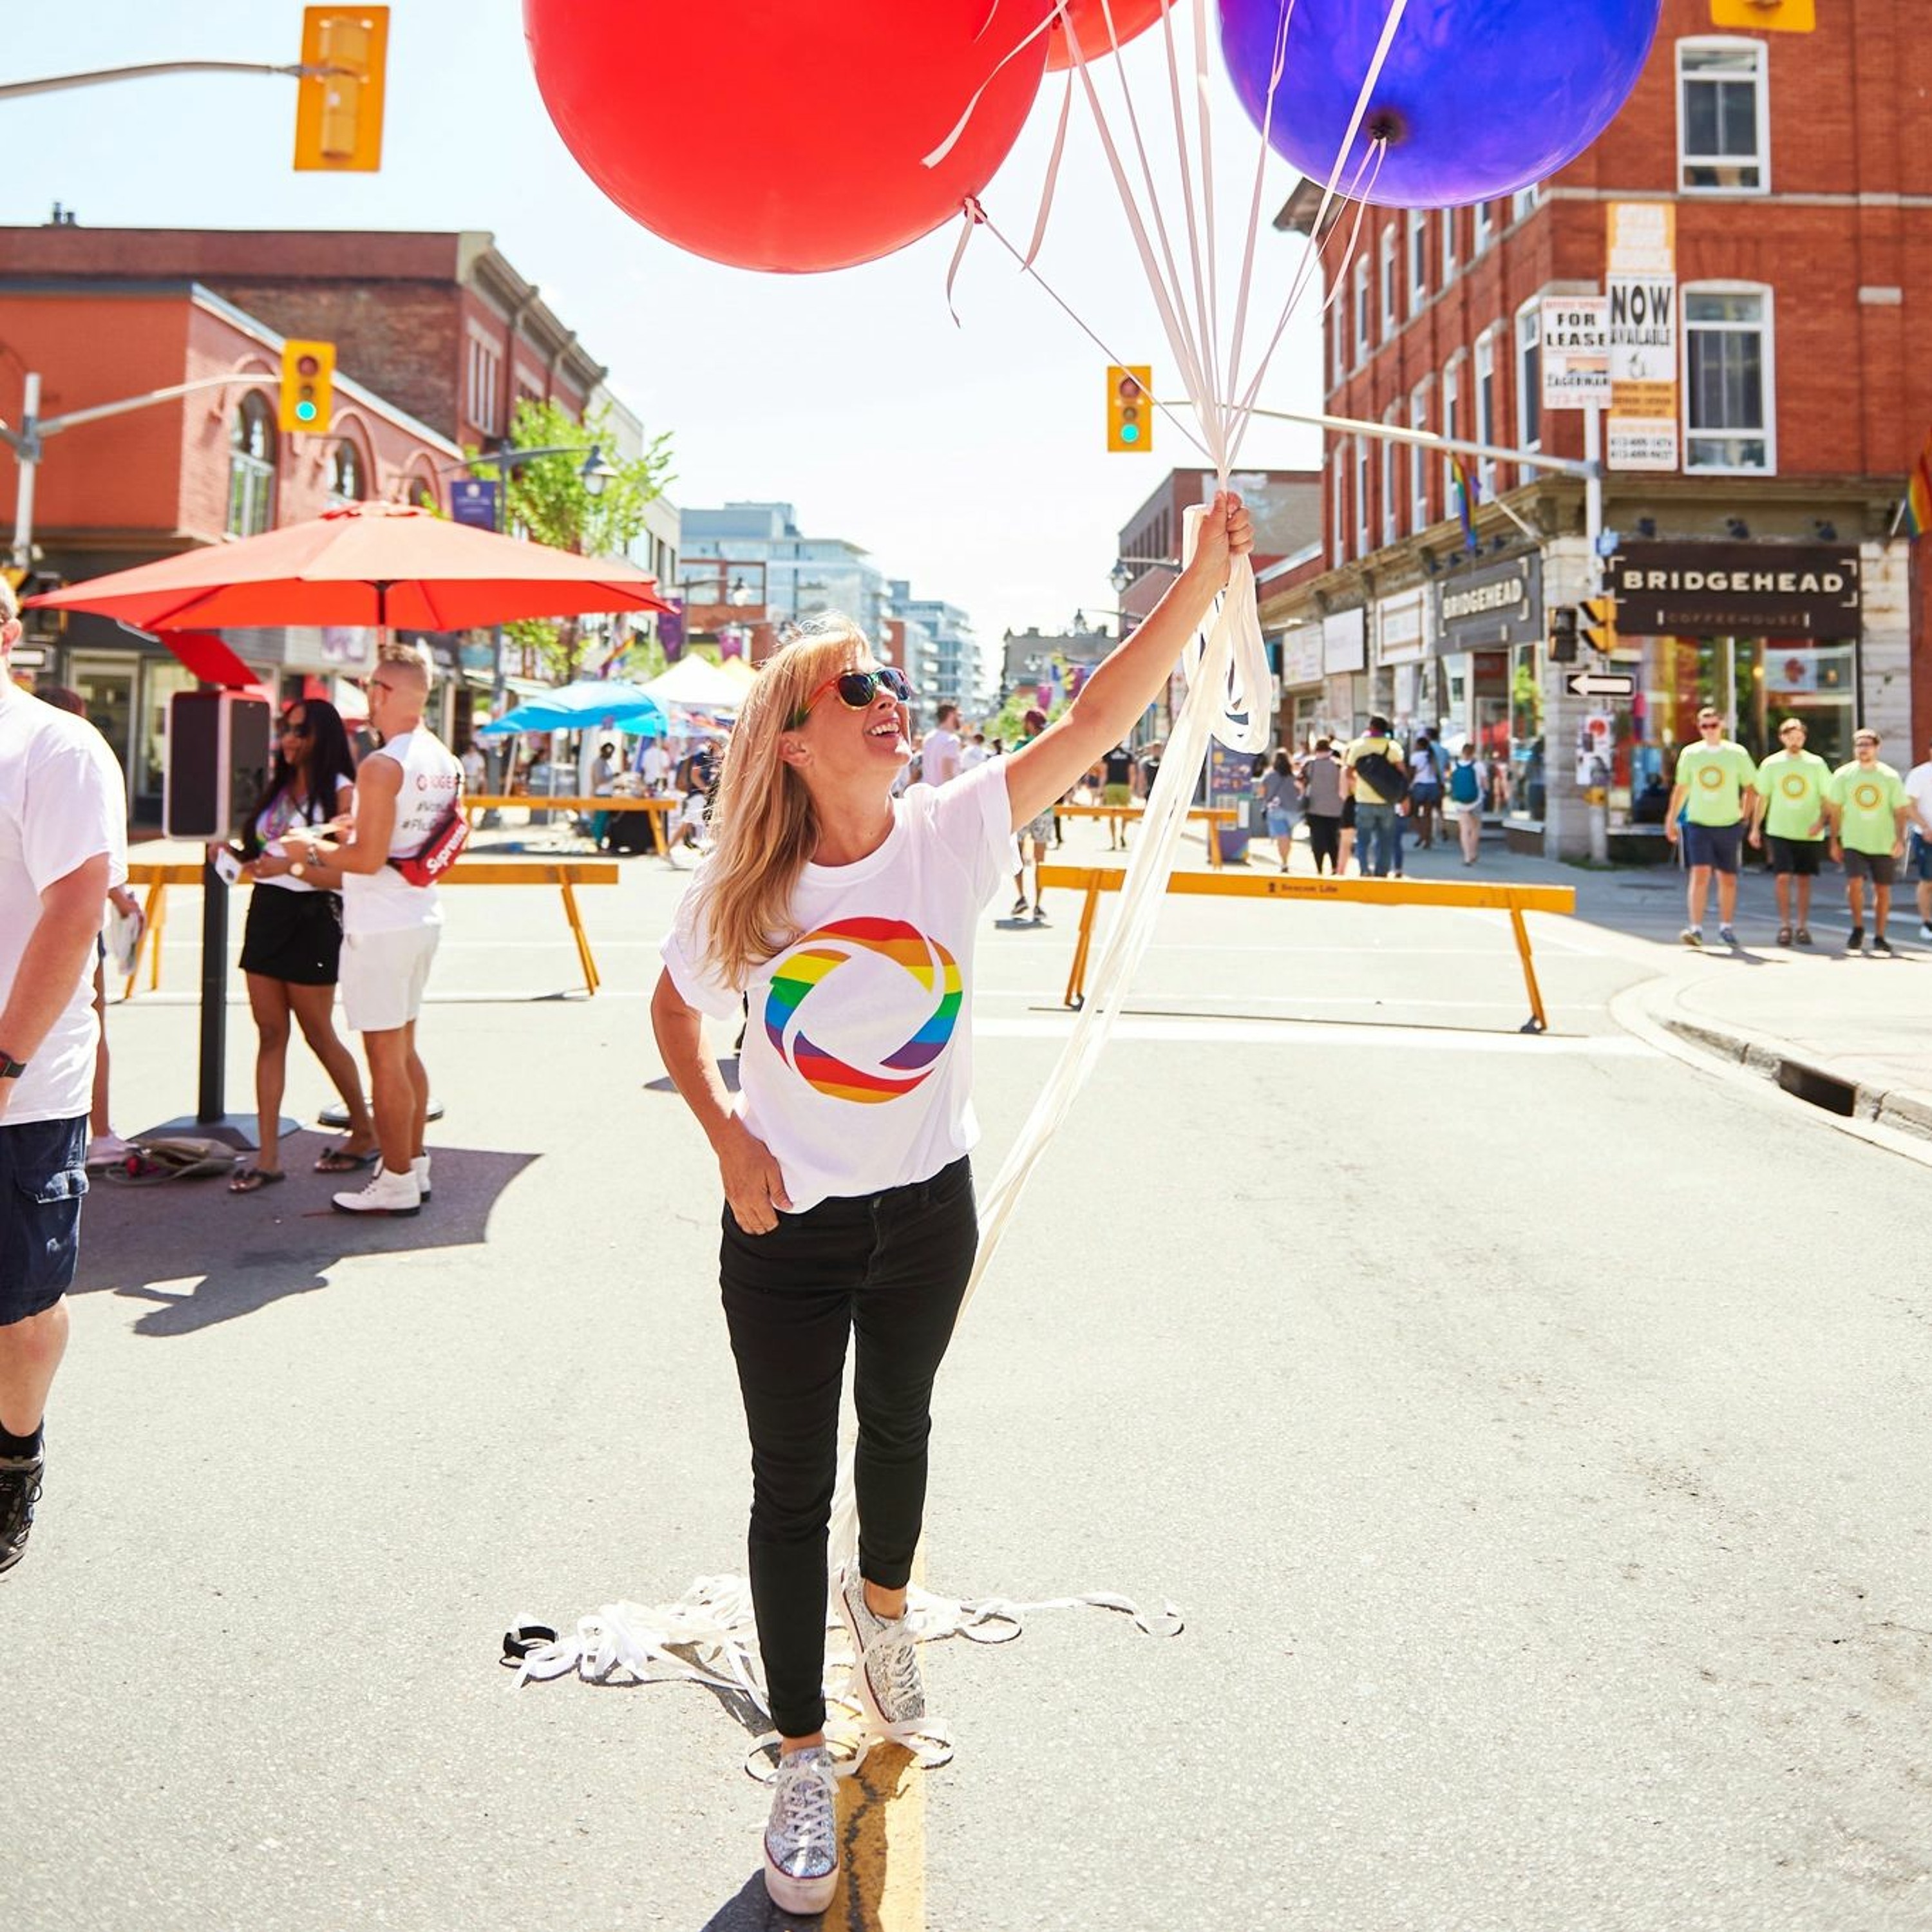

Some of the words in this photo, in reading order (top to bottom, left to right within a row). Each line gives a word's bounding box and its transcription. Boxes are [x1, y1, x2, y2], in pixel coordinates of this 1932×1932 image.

[1612, 285, 1671, 326] NOW
[1557, 313, 1595, 326] FOR
[1547, 333, 1605, 346] LEASE
[1611, 328, 1671, 345] AVAILABLE
[1623, 571, 1844, 592] BRIDGEHEAD
[1443, 578, 1522, 620] BRIDGEHEAD
[1667, 612, 1802, 625] COFFEEHOUSE
